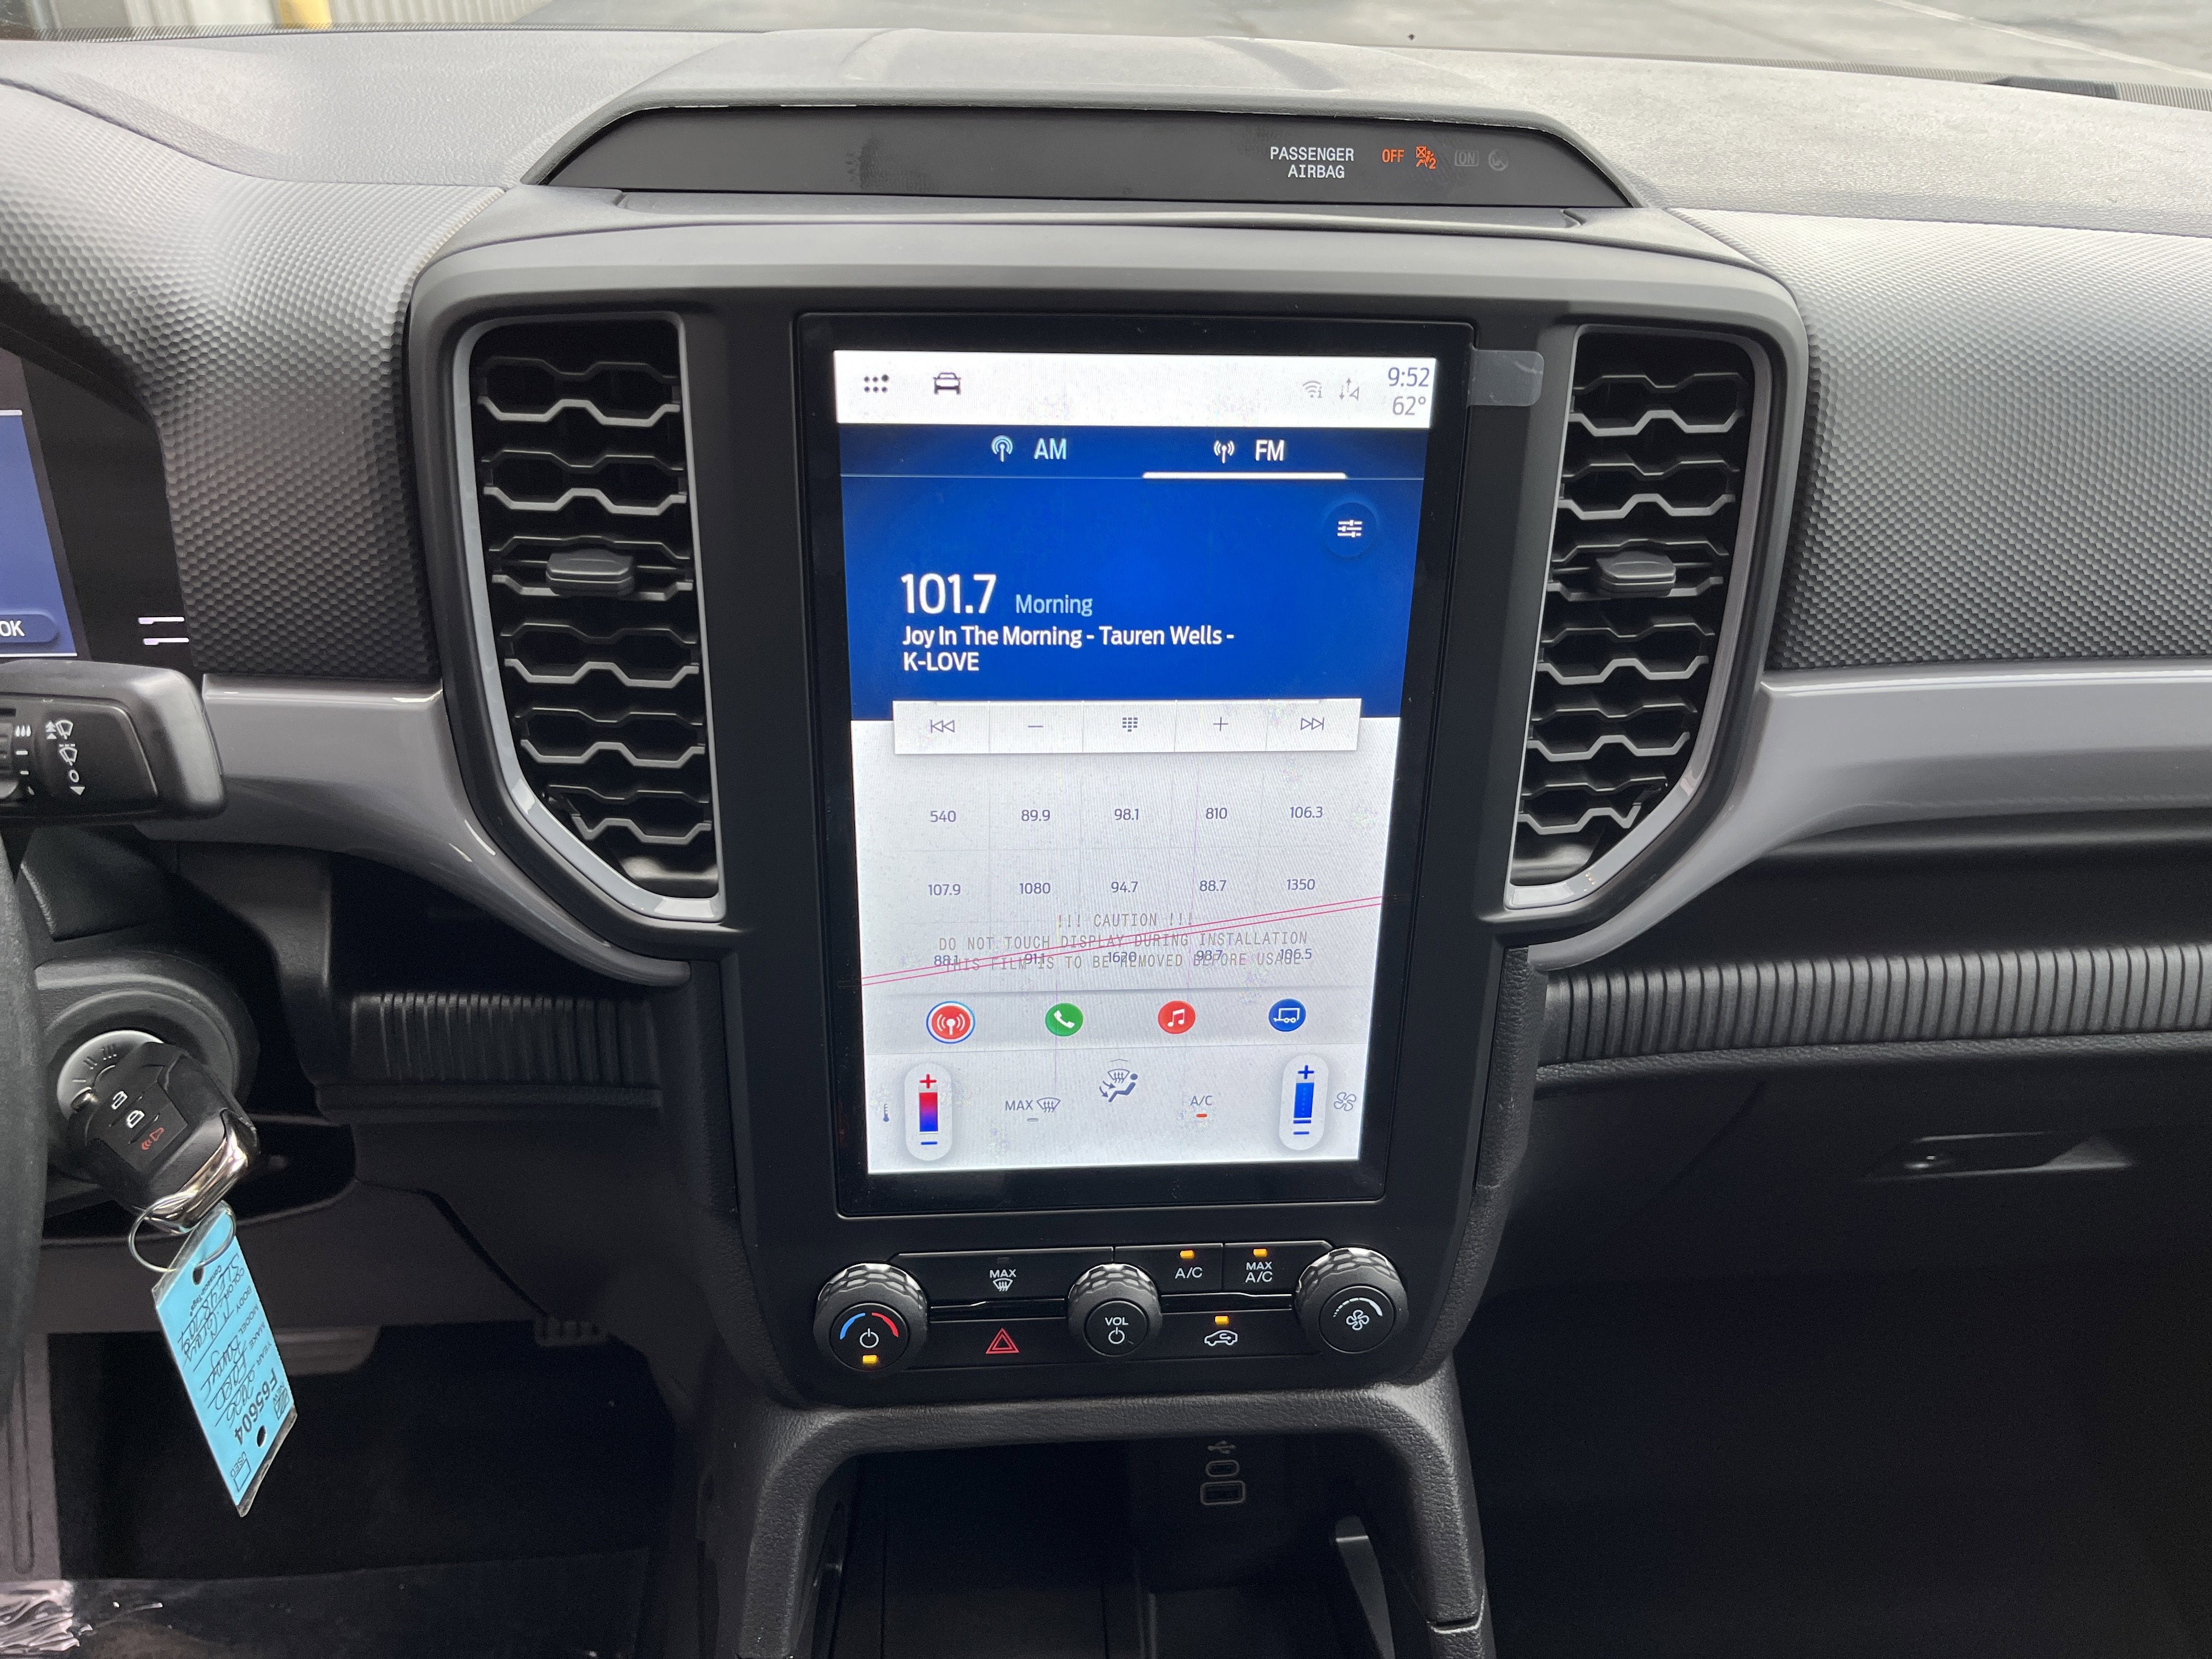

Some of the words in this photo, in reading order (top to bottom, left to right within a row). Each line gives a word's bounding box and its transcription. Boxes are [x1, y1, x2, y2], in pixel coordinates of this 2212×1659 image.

[1270, 146, 1354, 162] PASSENGER
[1382, 149, 1404, 163] OFF
[1288, 165, 1345, 178] AIRBAG
[1388, 367, 1430, 387] 9:52
[1034, 437, 1068, 460] AM
[1255, 439, 1285, 461] FM
[901, 573, 997, 615] 101.7
[1015, 594, 1093, 617] Morning
[0, 620, 25, 637] OK
[902, 626, 935, 648] Joy
[939, 625, 957, 645] In
[961, 625, 998, 645] The
[1002, 625, 1082, 648] Morning
[1098, 625, 1165, 645] Tauren
[1170, 625, 1222, 645] Wells
[903, 652, 979, 672] K-LOVE
[929, 809, 957, 823] 540
[1020, 808, 1051, 823] 89.9
[1113, 808, 1141, 821] 98.1
[1205, 806, 1229, 821] 810
[1288, 806, 1324, 820] 106.3
[928, 882, 962, 897] 107.9
[1018, 881, 1052, 896] 1080
[1110, 881, 1139, 895] 94.7
[1199, 879, 1227, 894] 88.7
[1285, 878, 1316, 892] 1350
[1093, 913, 1157, 928] CAUTION
[939, 937, 956, 951] DO
[968, 936, 994, 950] NOT
[1006, 935, 1050, 950] TOUCH
[1061, 933, 1124, 949] DISPLAY
[1135, 934, 1188, 947] DURING
[1199, 931, 1307, 946] INSTALLATION
[1065, 956, 1082, 969] TO
[1092, 955, 1109, 968] BE
[1121, 954, 1183, 968] REMOVED
[1005, 1100, 1033, 1111] MAX
[1190, 1095, 1214, 1107] A/C
[989, 1268, 1017, 1278] MAX
[1175, 1266, 1203, 1279] A/C
[1246, 1261, 1273, 1271] MAX
[1245, 1270, 1273, 1283] A/C
[235, 1285, 252, 1313] BODY
[238, 1303, 259, 1334] MODEL
[1104, 1317, 1129, 1326] VOL
[248, 1321, 266, 1349] MAKE
[256, 1341, 272, 1365] YEAR
[272, 1381, 285, 1405] NEW
[234, 1368, 278, 1444] F65604
[229, 1451, 246, 1478] USED
